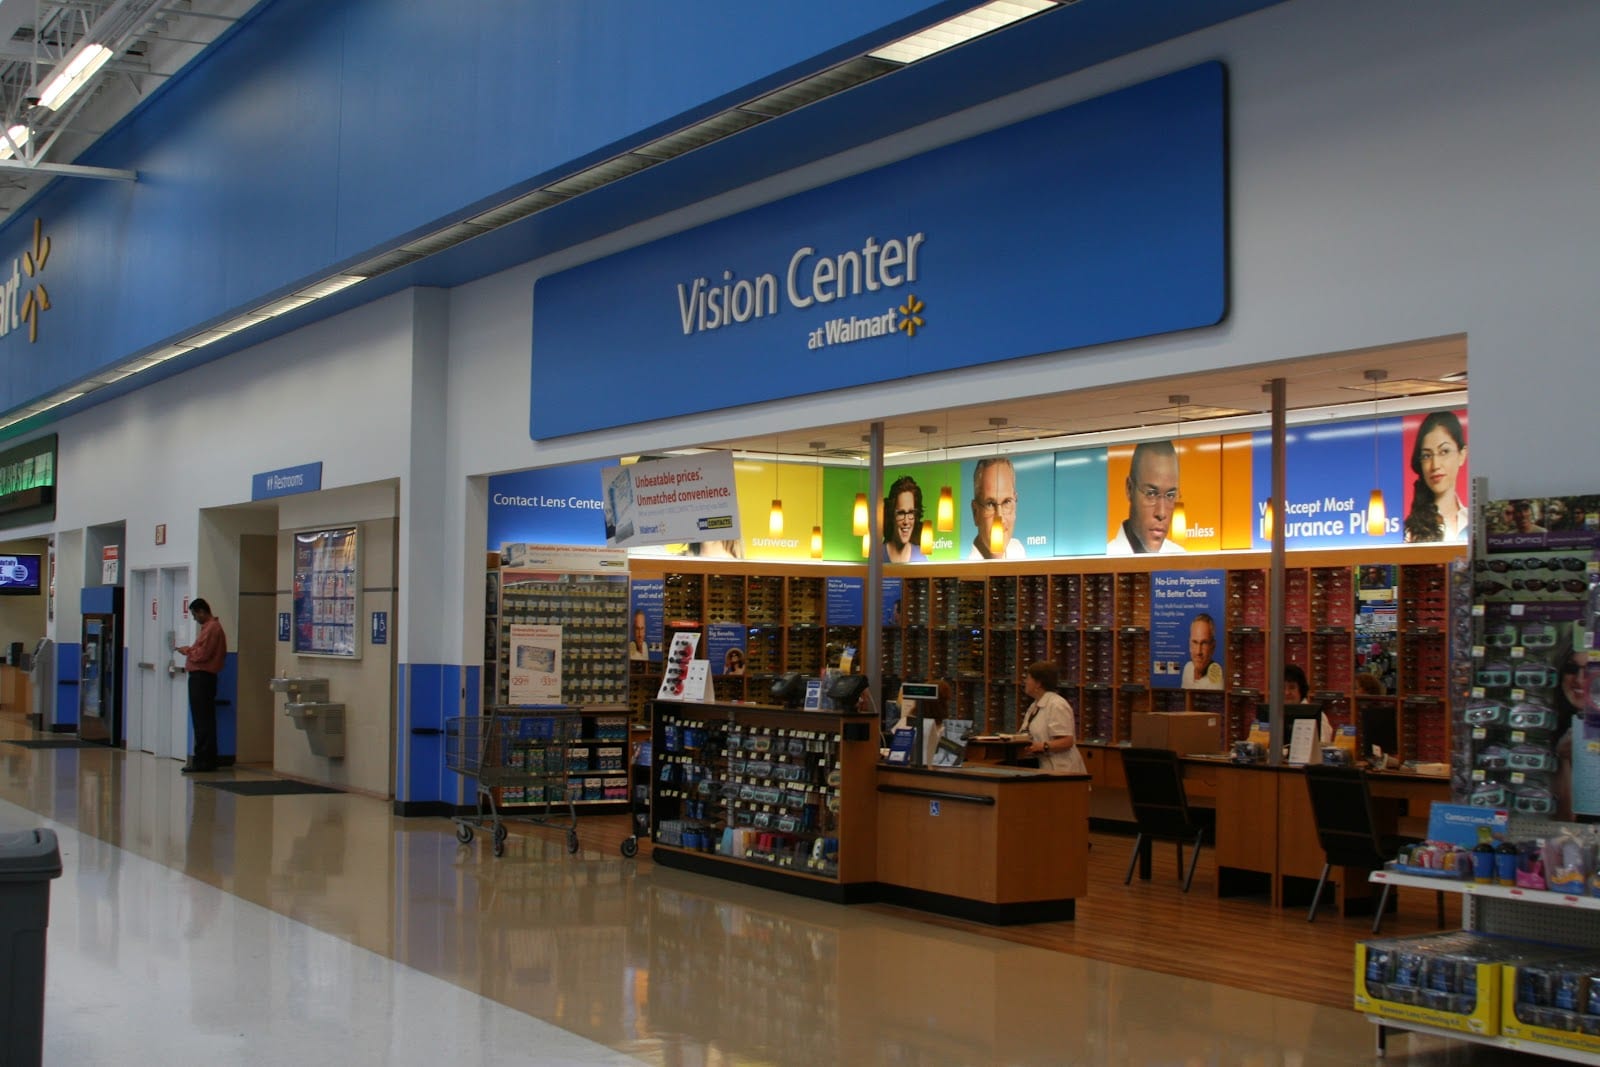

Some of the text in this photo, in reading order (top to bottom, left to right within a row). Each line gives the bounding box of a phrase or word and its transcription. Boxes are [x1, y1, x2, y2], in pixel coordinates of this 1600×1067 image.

[677, 232, 925, 335] Vision Center
[808, 307, 898, 350] at Walmart
[274, 474, 304, 490] Restrooms
[635, 472, 675, 489] Unbeatable
[493, 493, 605, 510] Contact Lens Center
[637, 486, 731, 506] Unmatched convenience.
[1284, 500, 1321, 518] Accept
[1324, 497, 1354, 513] Most
[1260, 509, 1400, 539] Iurance Plns
[752, 537, 799, 549] sunwear
[1026, 535, 1047, 545] men
[1155, 575, 1220, 587] No-Line Progressives:
[1155, 588, 1208, 598] The Better Choice
